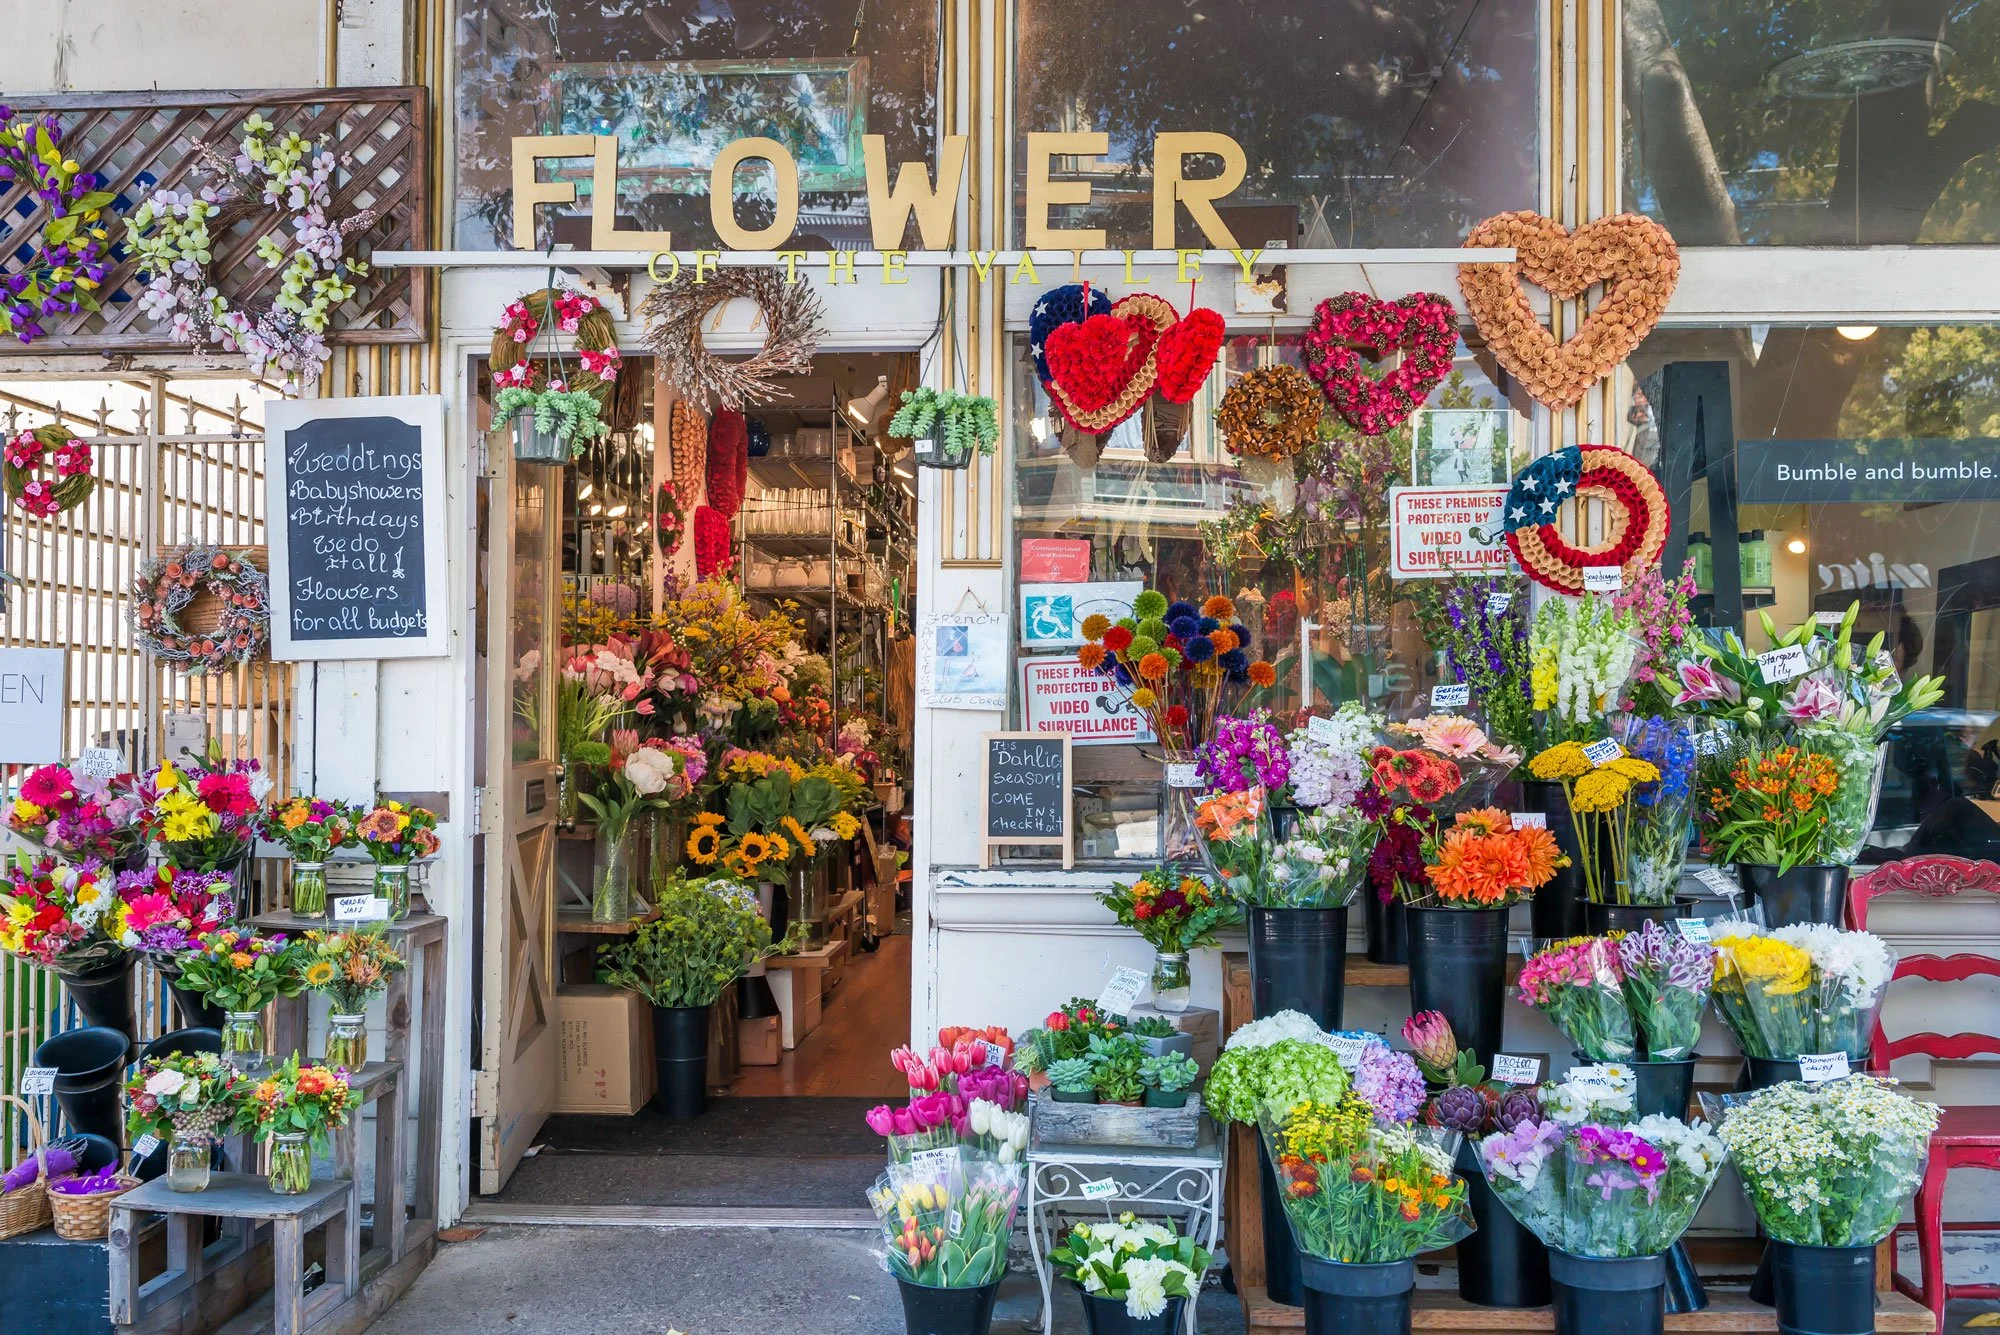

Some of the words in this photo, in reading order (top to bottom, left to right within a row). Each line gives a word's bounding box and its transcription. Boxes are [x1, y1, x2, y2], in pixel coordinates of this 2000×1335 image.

[512, 132, 1247, 251] FLOWER
[647, 249, 721, 284] OF
[777, 249, 909, 284] THE
[968, 248, 1264, 284] VALLEY
[293, 442, 422, 480] Weddings
[1777, 463, 1857, 481] Bumble
[1865, 462, 1904, 480] and
[1912, 461, 1999, 480] bumble.
[293, 479, 423, 512] Babyshowers
[1408, 498, 1442, 510] THESE
[1446, 496, 1502, 508] PREMISES
[295, 504, 418, 539] Birthdays
[1408, 512, 1471, 525] PROTECTED
[1475, 512, 1490, 523] BY
[1421, 531, 1462, 546] VIDEO
[1408, 549, 1511, 566] SURVEILLANCE
[296, 576, 399, 601] Flowers
[293, 608, 325, 632] for
[328, 606, 362, 631] all
[369, 607, 427, 636] budgets
[1036, 668, 1070, 680] THESE
[1037, 682, 1098, 695] PROTECTED
[1102, 681, 1116, 692] BY
[1049, 700, 1090, 715] VIDEO
[1038, 718, 1138, 733] SURVEILLANCE
[86, 750, 109, 761] LOCAL
[86, 760, 113, 769] MIXED
[991, 792, 1035, 805] COME
[1026, 807, 1045, 818] IN
